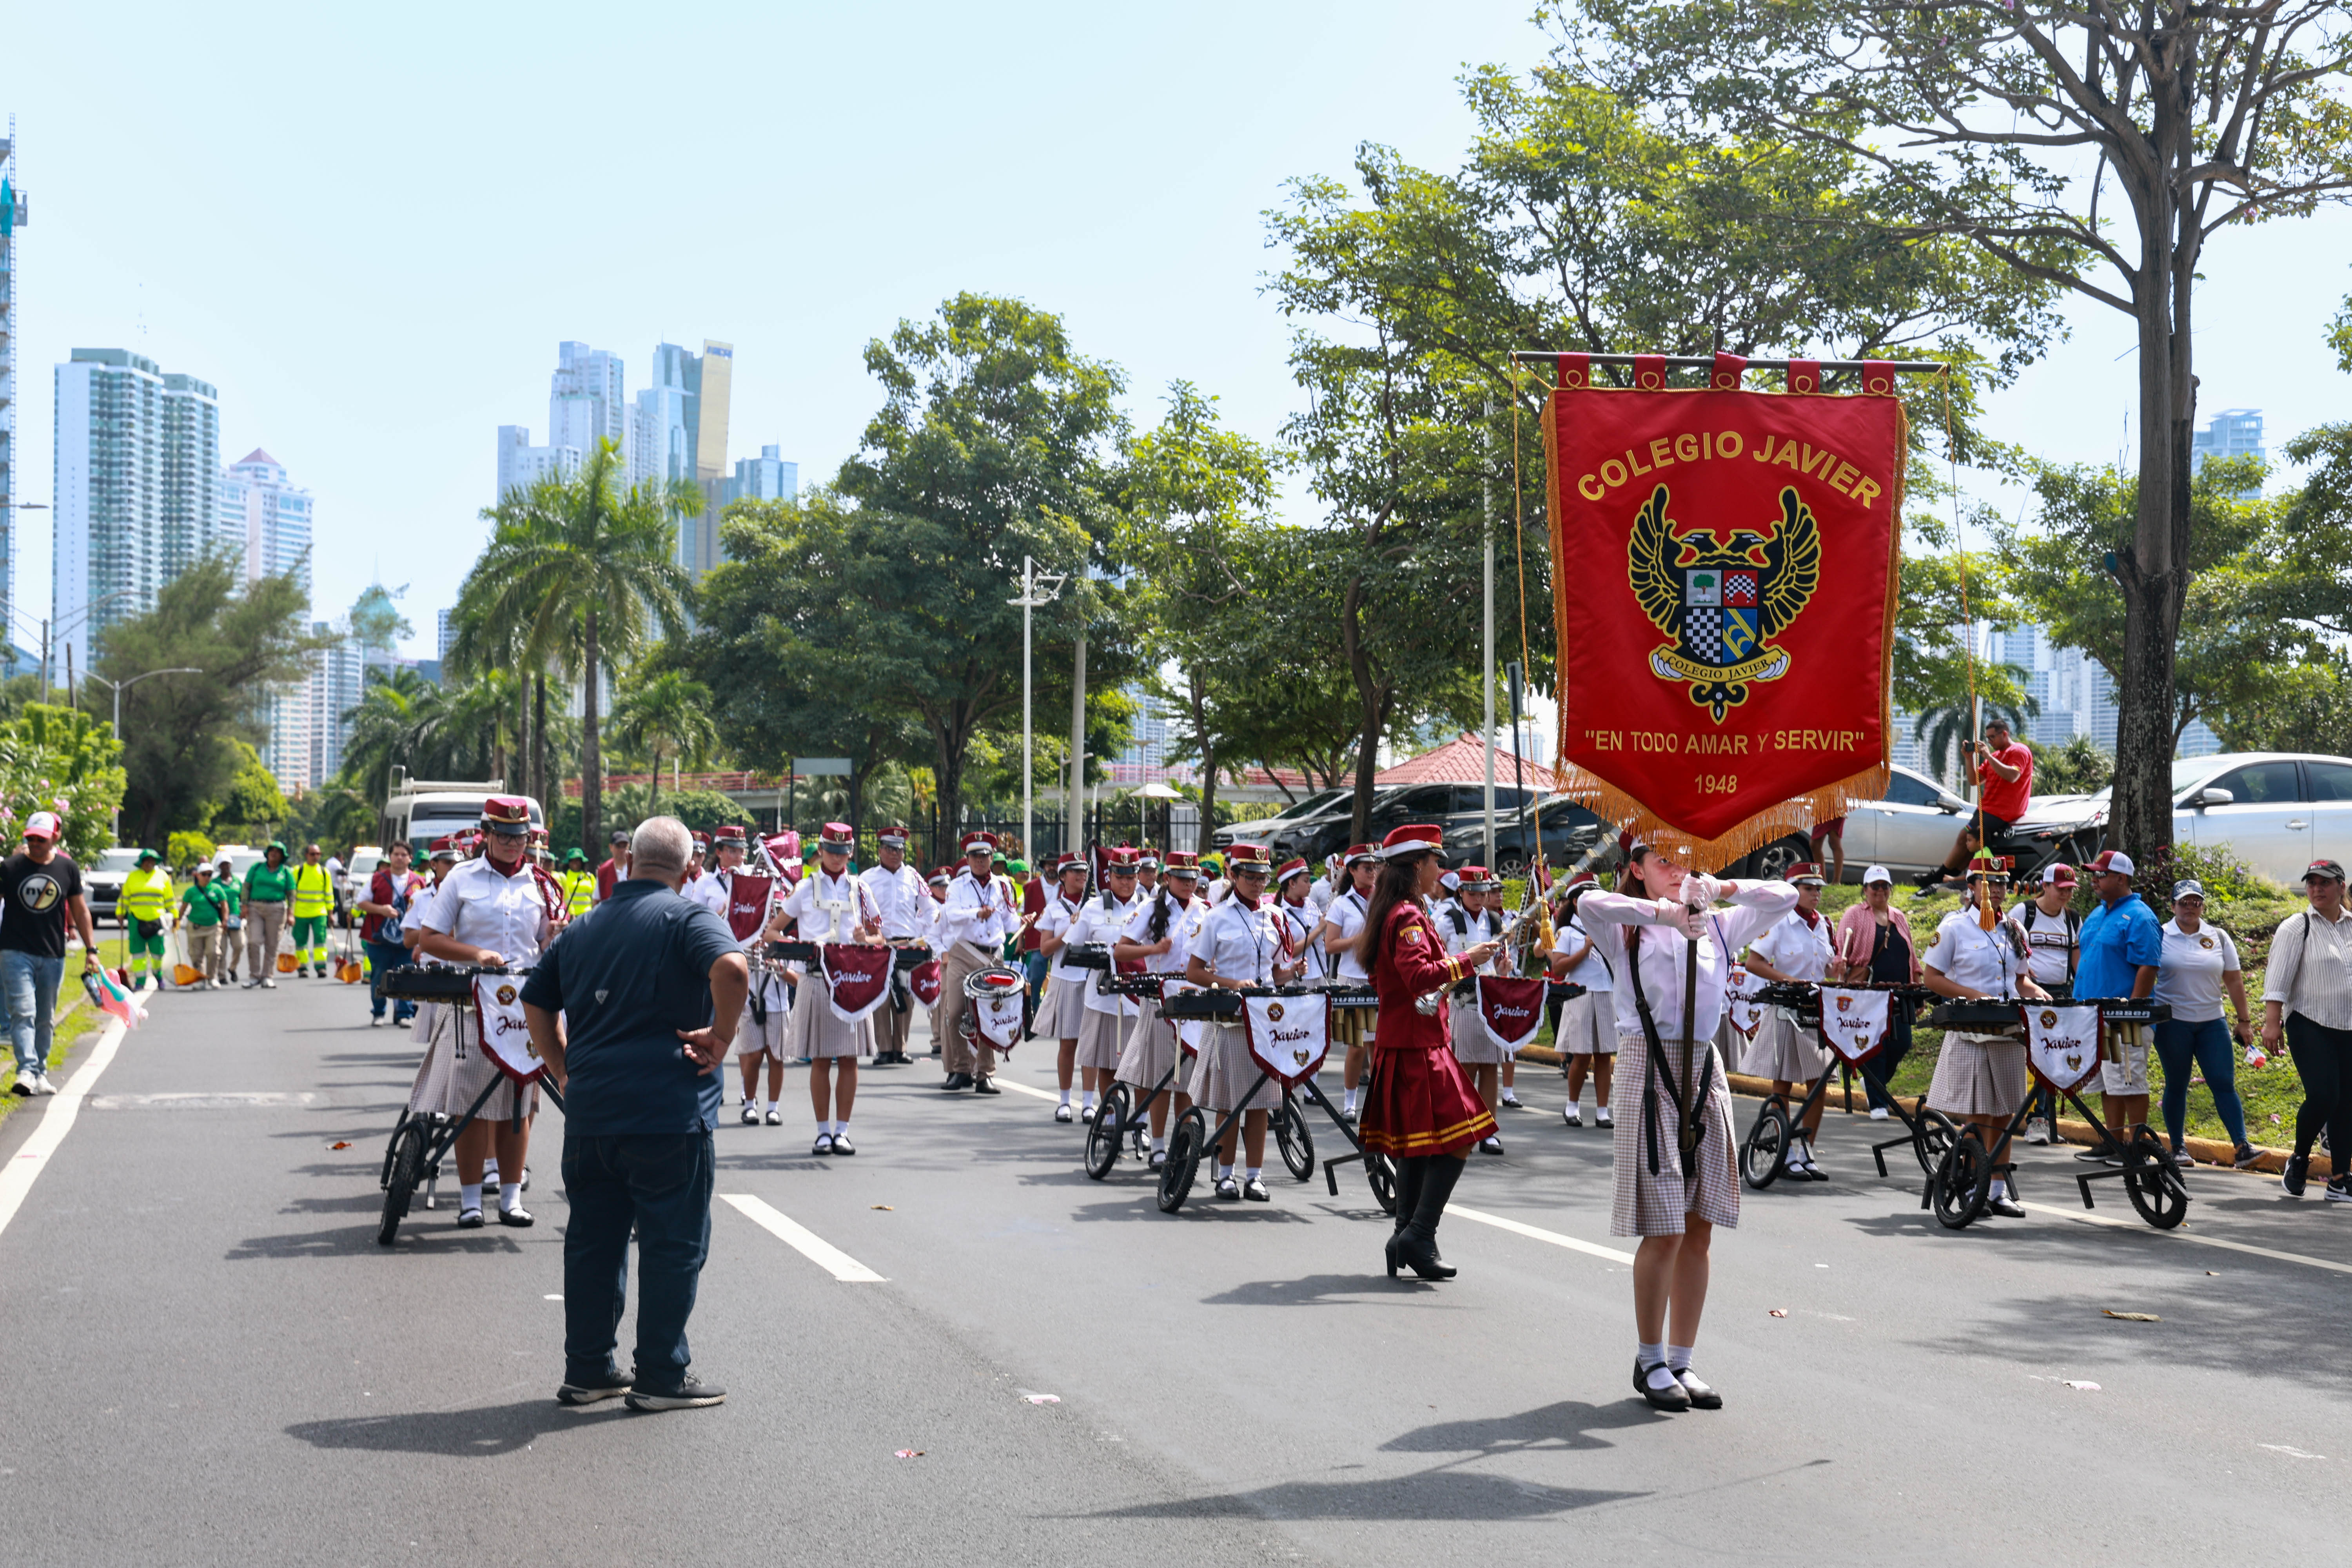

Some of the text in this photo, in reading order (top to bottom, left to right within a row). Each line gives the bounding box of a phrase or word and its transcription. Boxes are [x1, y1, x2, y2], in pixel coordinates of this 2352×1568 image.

[1578, 431, 1881, 509] COLEGIO JAVIER
[1668, 656, 1769, 680] COLEGIO JAVIER
[1631, 731, 1678, 753] TODO
[1685, 734, 1748, 755] AMAR
[1757, 733, 1769, 752] Y
[1695, 774, 1737, 793] 1948
[26, 887, 54, 897] nyc
[833, 970, 872, 987] Javier
[1494, 1003, 1530, 1019] Javier
[991, 1015, 1018, 1031] Javier
[1837, 1017, 1871, 1033] Javier
[1269, 1028, 1310, 1048] Javier
[2041, 1036, 2081, 1054] Javier
